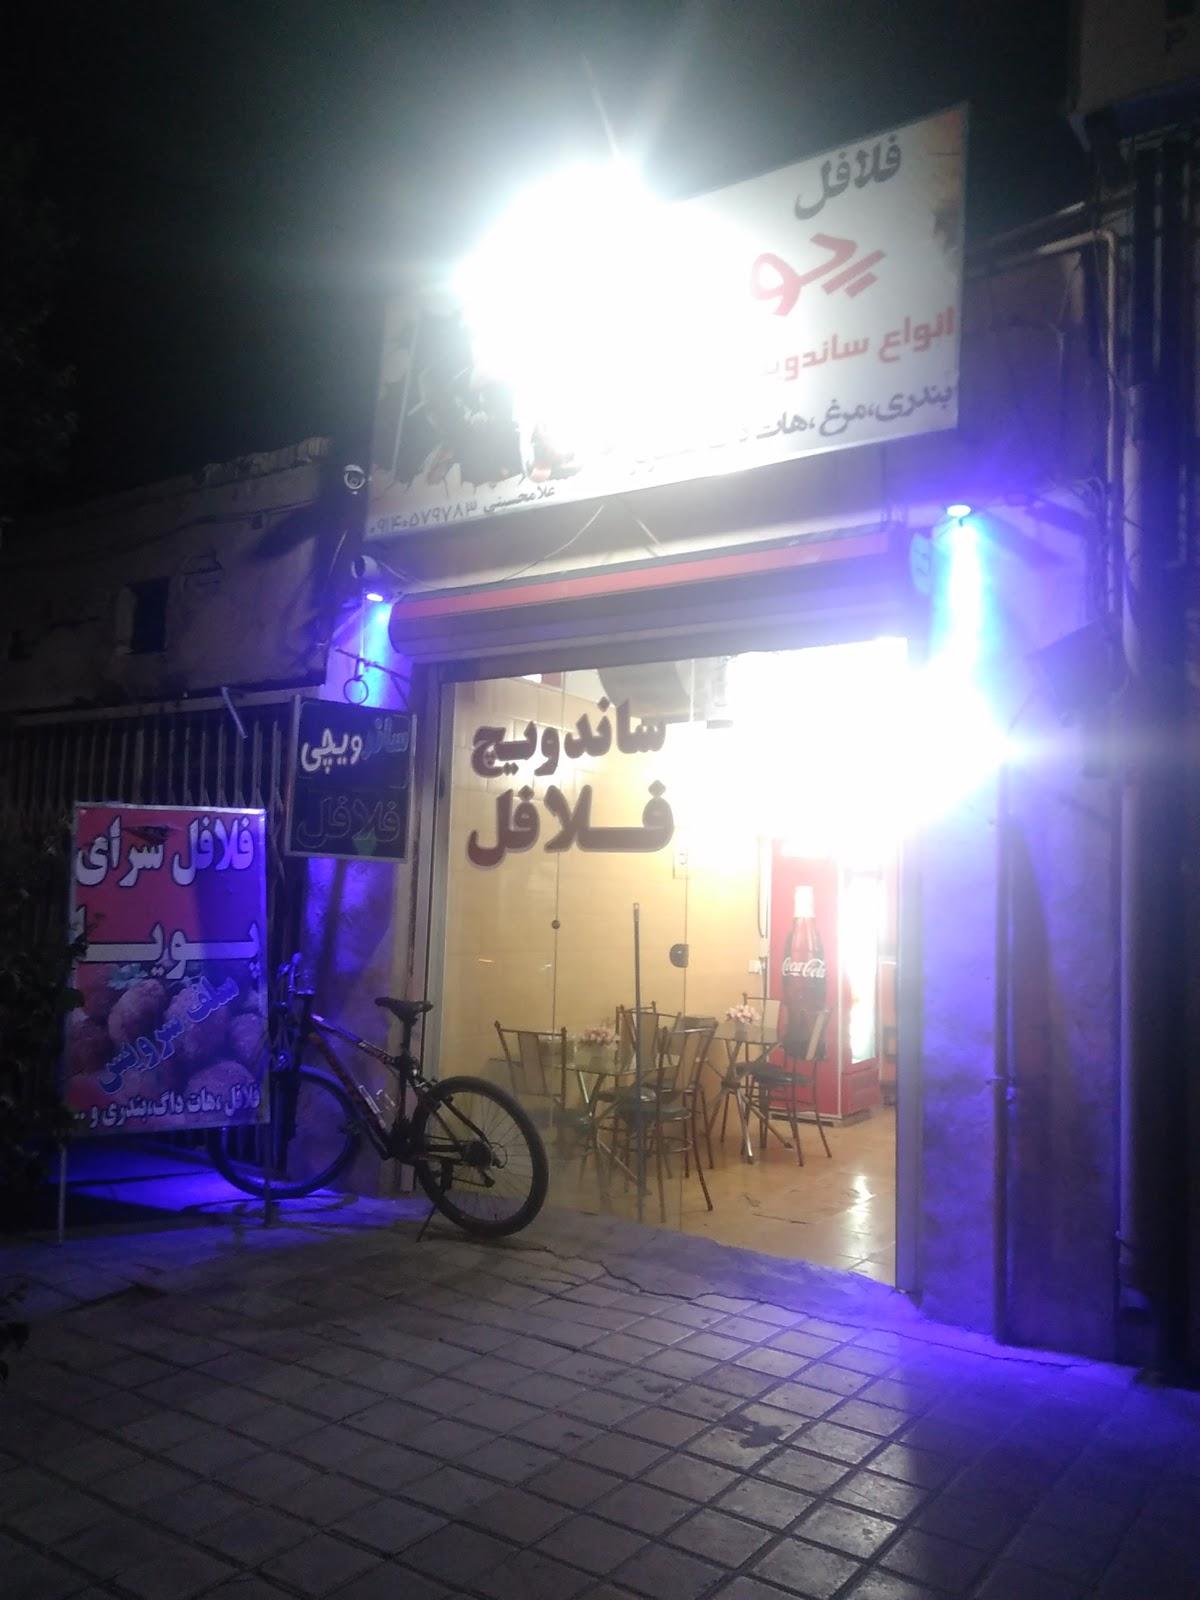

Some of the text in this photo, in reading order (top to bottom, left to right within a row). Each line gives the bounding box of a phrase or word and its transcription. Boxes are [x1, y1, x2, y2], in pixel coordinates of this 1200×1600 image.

[794, 134, 902, 221] فلافل
[879, 307, 955, 363] انواع
[471, 697, 666, 778] ساندویچ
[76, 815, 255, 888] فلافل سرای
[296, 796, 401, 848] فلافل
[466, 780, 675, 869] فلافل
[100, 975, 240, 1094] سلف سرویس
[223, 1082, 261, 1117] فلافل
